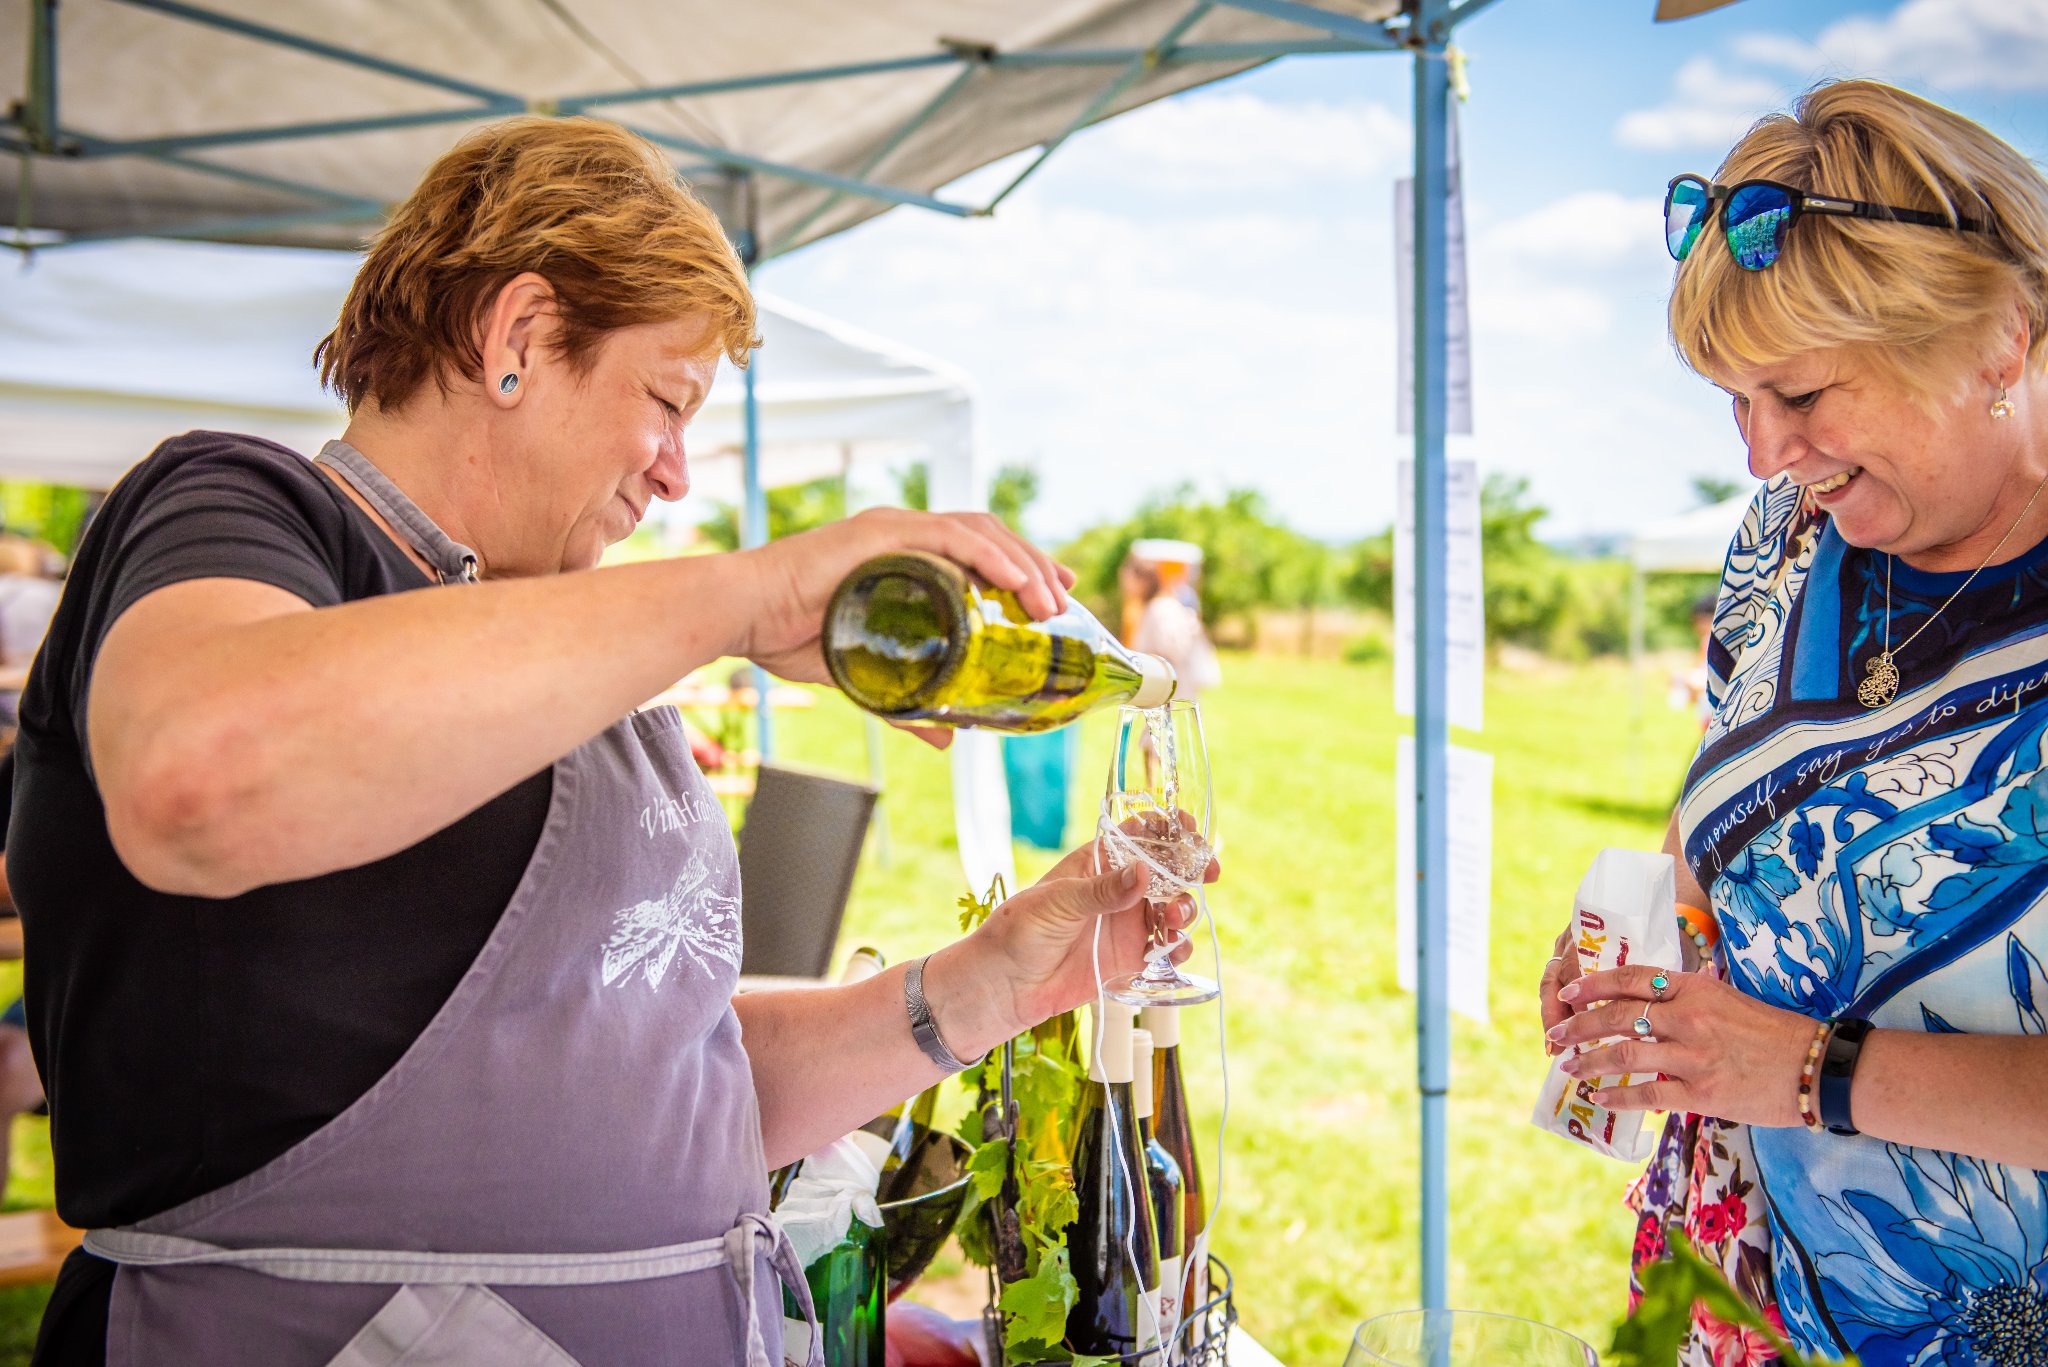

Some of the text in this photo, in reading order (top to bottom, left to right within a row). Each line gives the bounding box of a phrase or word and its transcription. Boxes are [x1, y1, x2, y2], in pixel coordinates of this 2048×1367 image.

[1703, 773, 1786, 873] yourself.
[1796, 747, 1854, 786] say
[1865, 722, 1913, 762] yes
[1915, 698, 1957, 736] to
